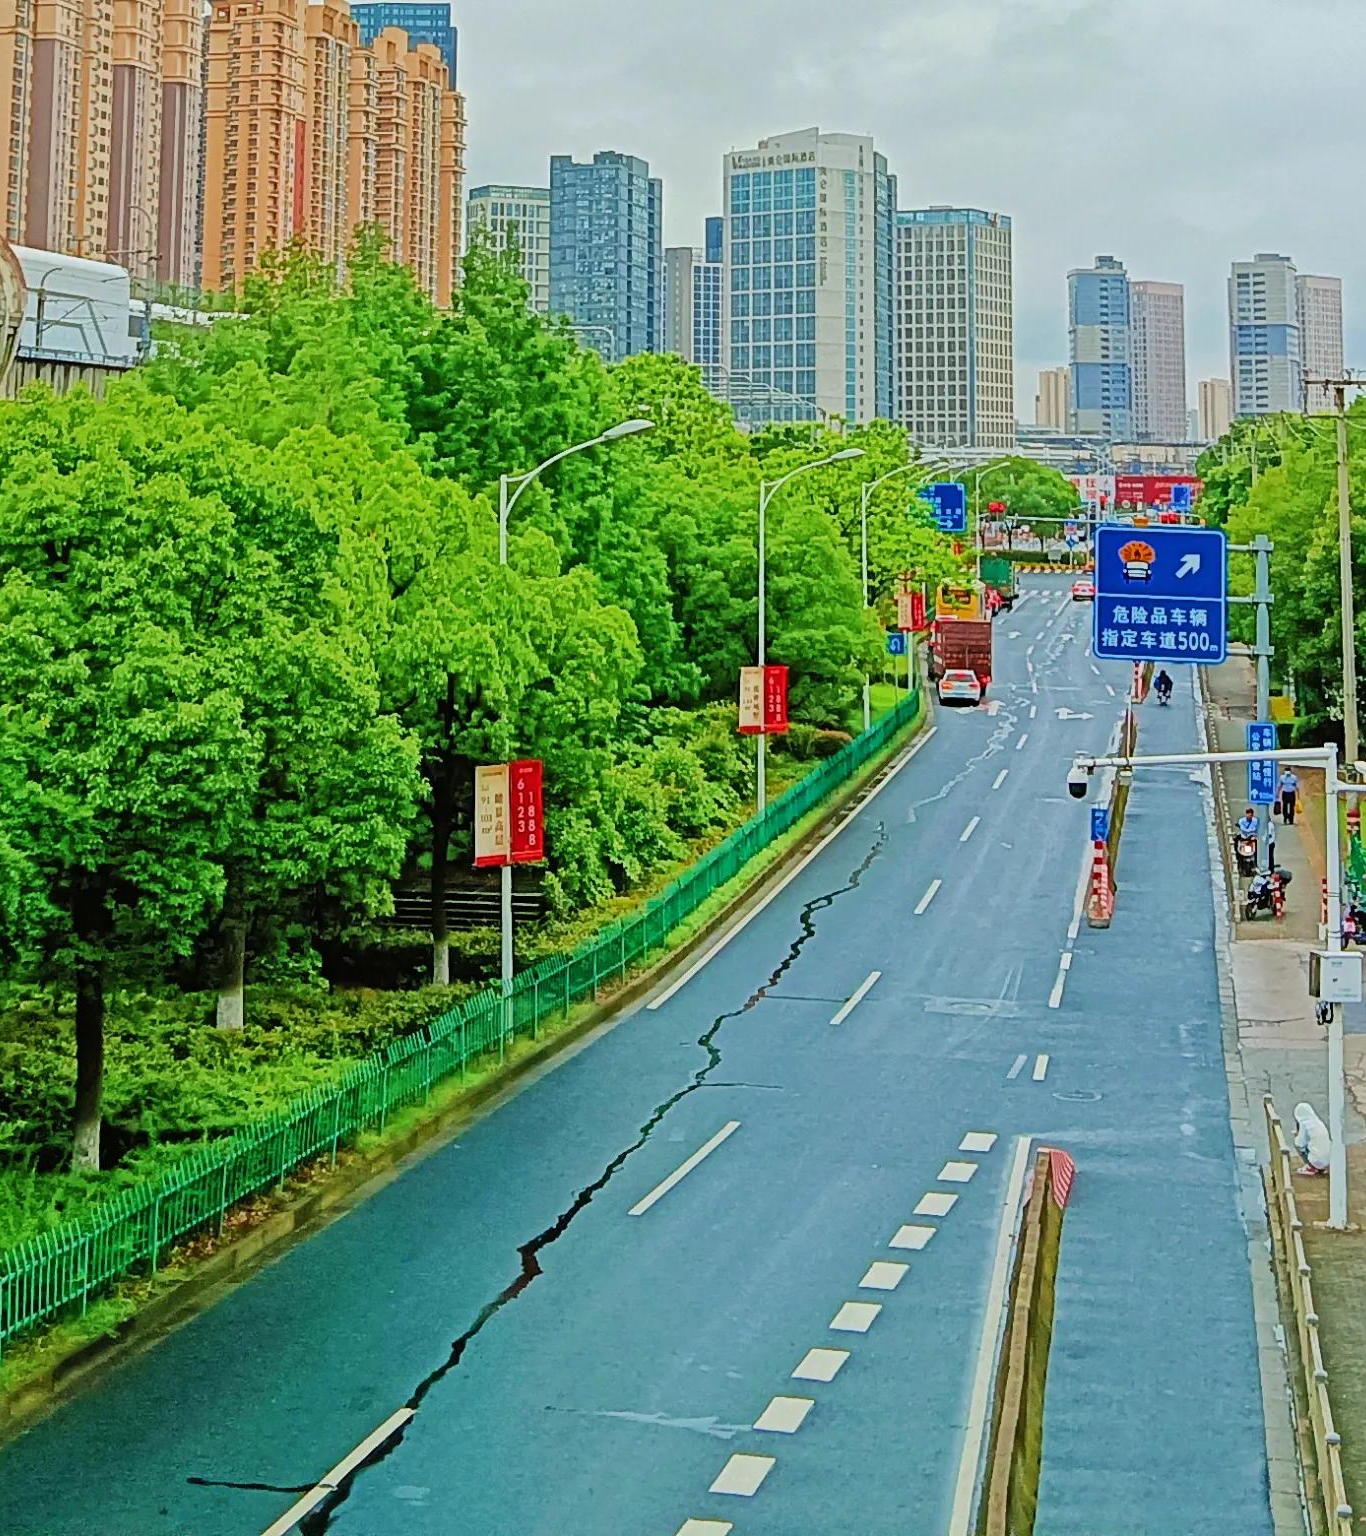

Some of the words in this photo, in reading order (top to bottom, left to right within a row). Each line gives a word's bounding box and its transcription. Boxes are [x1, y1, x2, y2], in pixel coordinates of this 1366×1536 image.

[1101, 629, 1219, 652] 指定车道500m
[1112, 605, 1208, 627] 危险品车辆
[1251, 732, 1261, 781] 公安查站
[1263, 728, 1272, 787] 车辆速慢行
[517, 778, 525, 833] 6123
[528, 792, 536, 845] 1888
